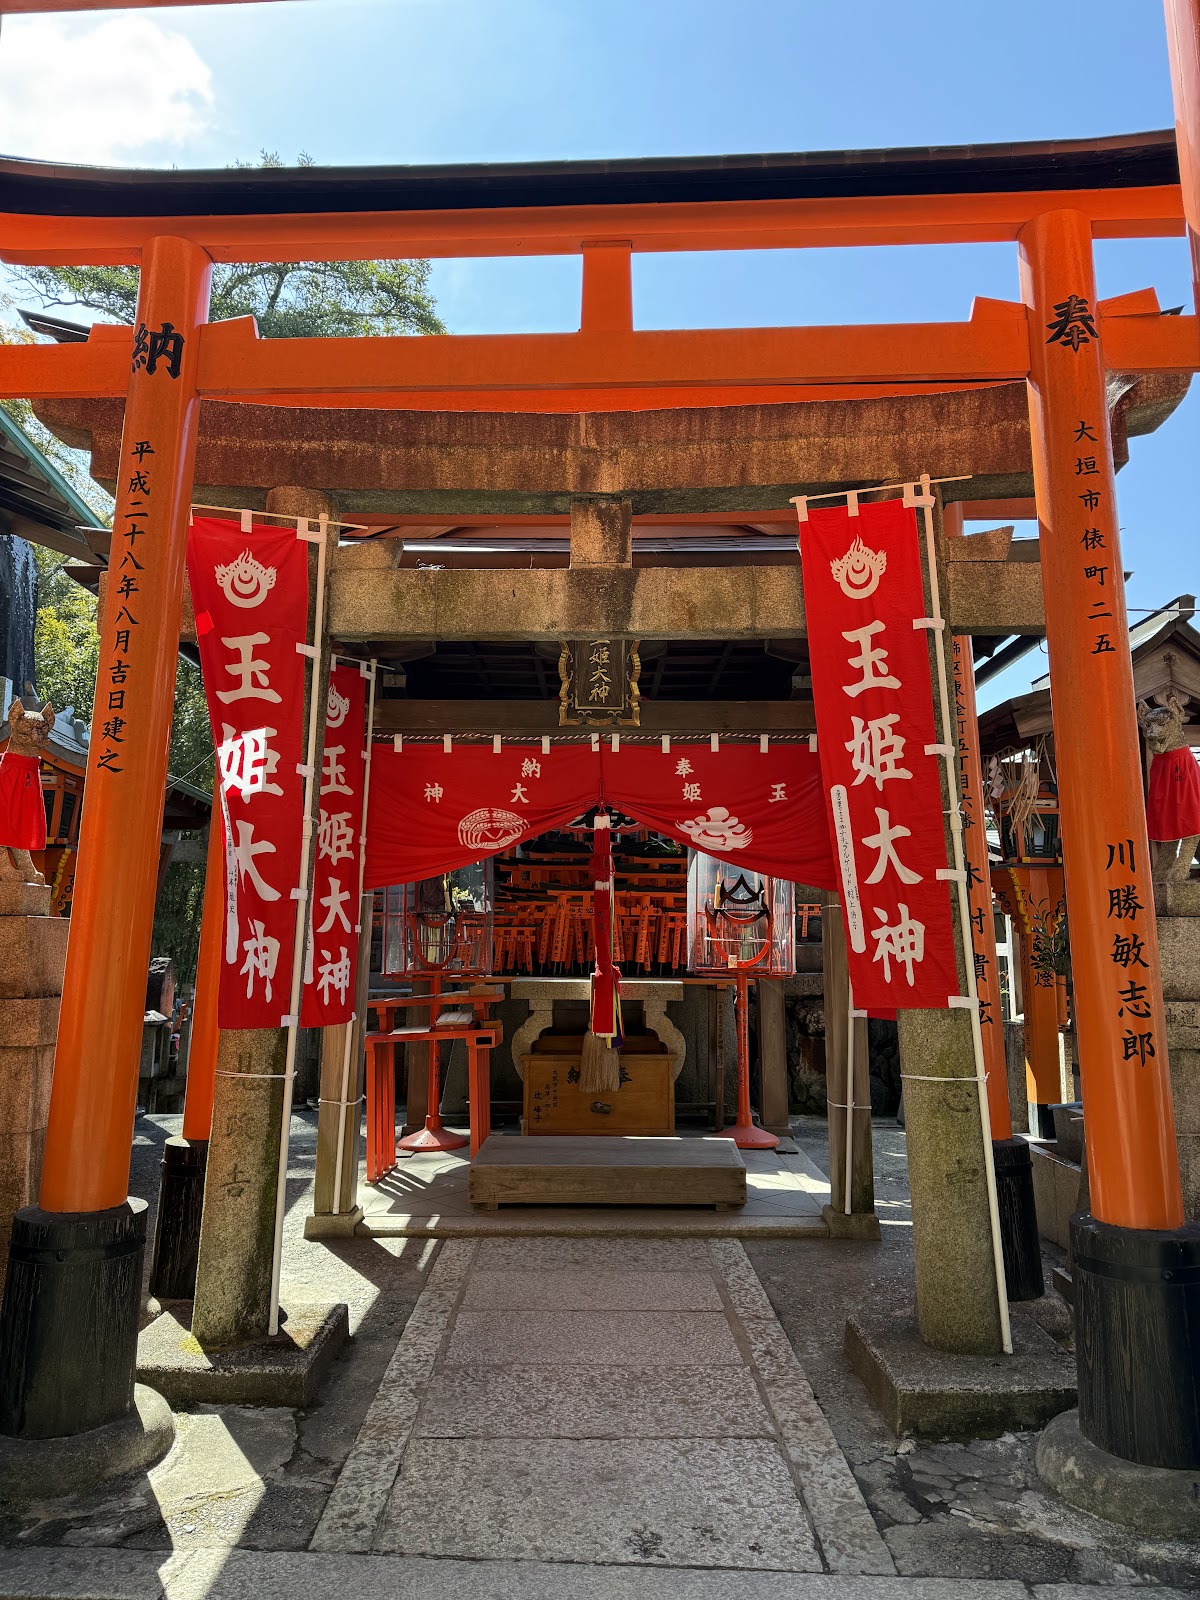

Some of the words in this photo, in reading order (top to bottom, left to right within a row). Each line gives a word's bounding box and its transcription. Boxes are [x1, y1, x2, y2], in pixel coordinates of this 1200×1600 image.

[131, 322, 185, 380] 納
[1045, 294, 1099, 353] 奉
[1073, 420, 1117, 655] 大垣市俵町二五
[96, 440, 156, 774] 平成二十八年八月吉日建之
[424, 783, 445, 804] 神
[510, 783, 531, 804] 大
[521, 758, 541, 778] 納
[675, 758, 695, 778] 奉
[682, 782, 703, 804] 姫
[768, 783, 789, 804] 玉
[215, 631, 284, 1004] 玉姫大神
[842, 619, 926, 987] 玉姫大神
[315, 744, 355, 1007] 玉姫大神
[1106, 838, 1157, 1067] 川勝敏志郎
